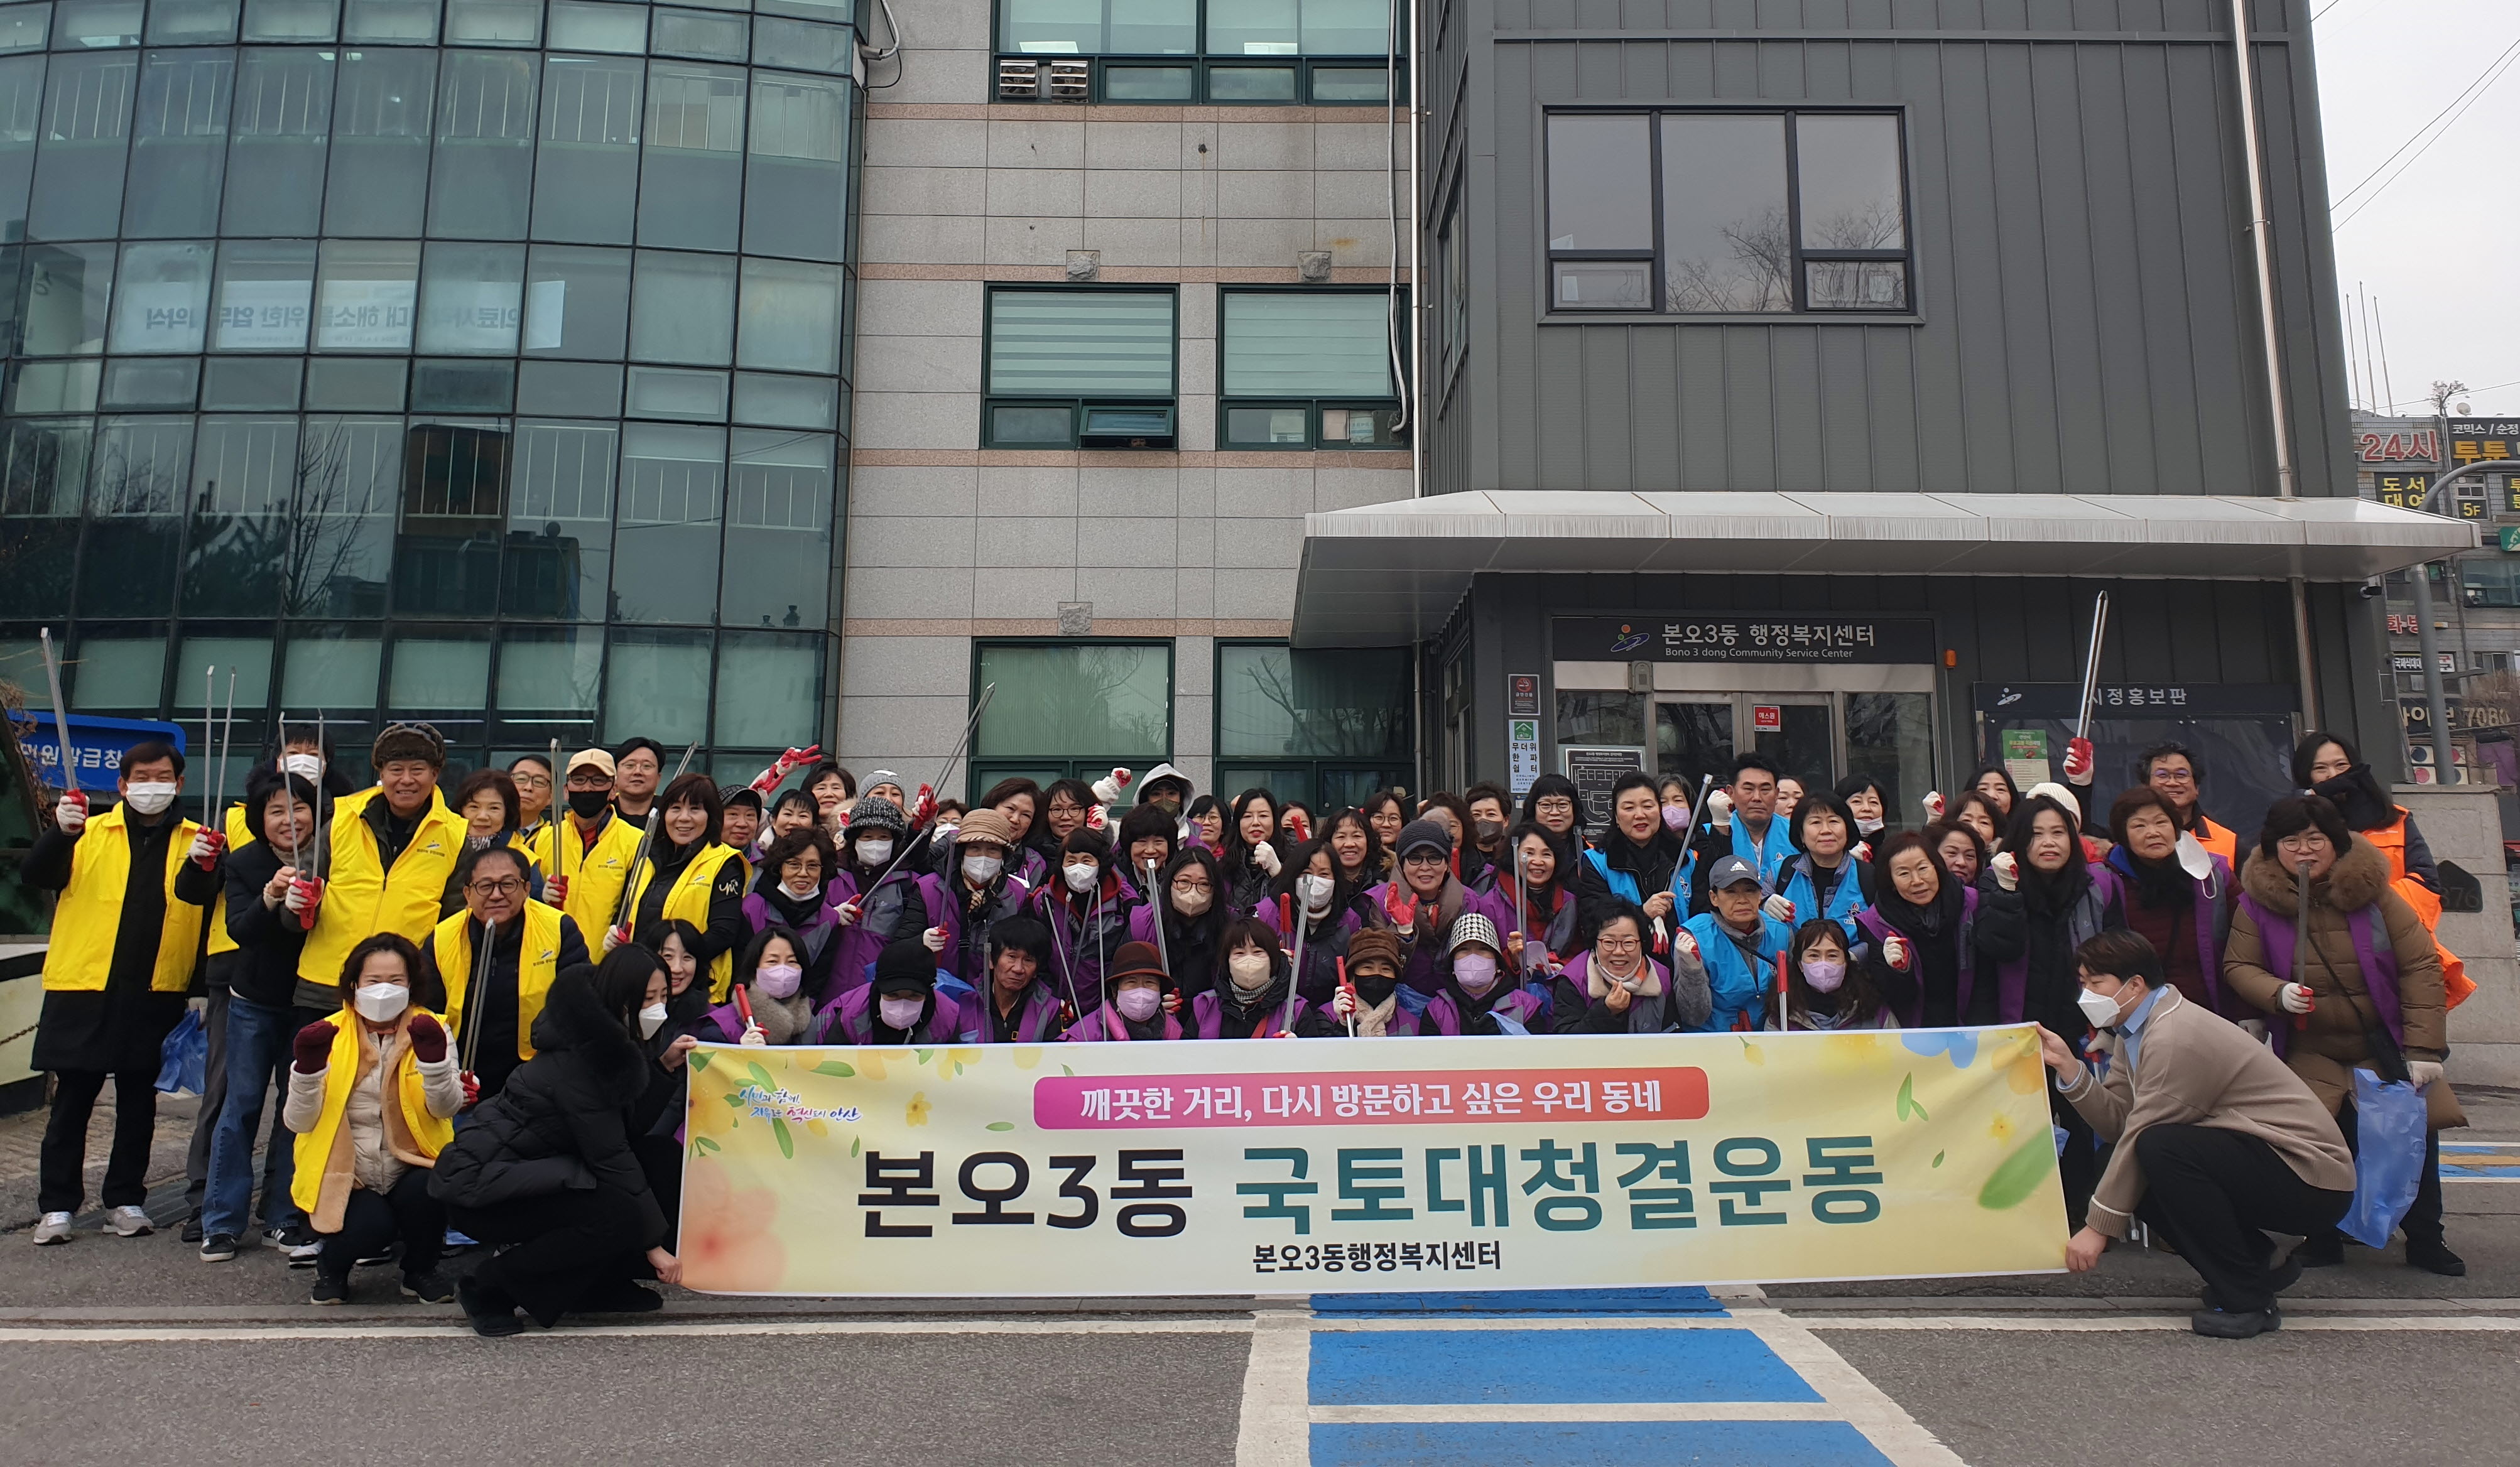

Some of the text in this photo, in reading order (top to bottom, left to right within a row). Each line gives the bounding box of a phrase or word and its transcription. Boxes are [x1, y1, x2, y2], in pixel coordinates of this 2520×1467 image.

[2452, 424, 2487, 435] 코믹스
[2360, 430, 2441, 462] 24시
[2382, 477, 2426, 493] 도서
[2463, 502, 2481, 517] 5F
[1661, 624, 1874, 647] 본오3동 행정복지센터
[1665, 647, 1853, 659] Bono 3 dong Community Service Center
[1512, 742, 1537, 752] 무더위
[739, 1085, 772, 1107] 시민과
[1080, 1080, 1661, 1122] 깨끗한 거리, 다시 방문하고 싶은 우리 동네
[750, 1107, 862, 1124] 자유로운 혁신도시 안산
[858, 1135, 1883, 1238] 본오3동 국토대청결운동
[1252, 1240, 1501, 1273] 본오3동행정복지센터
